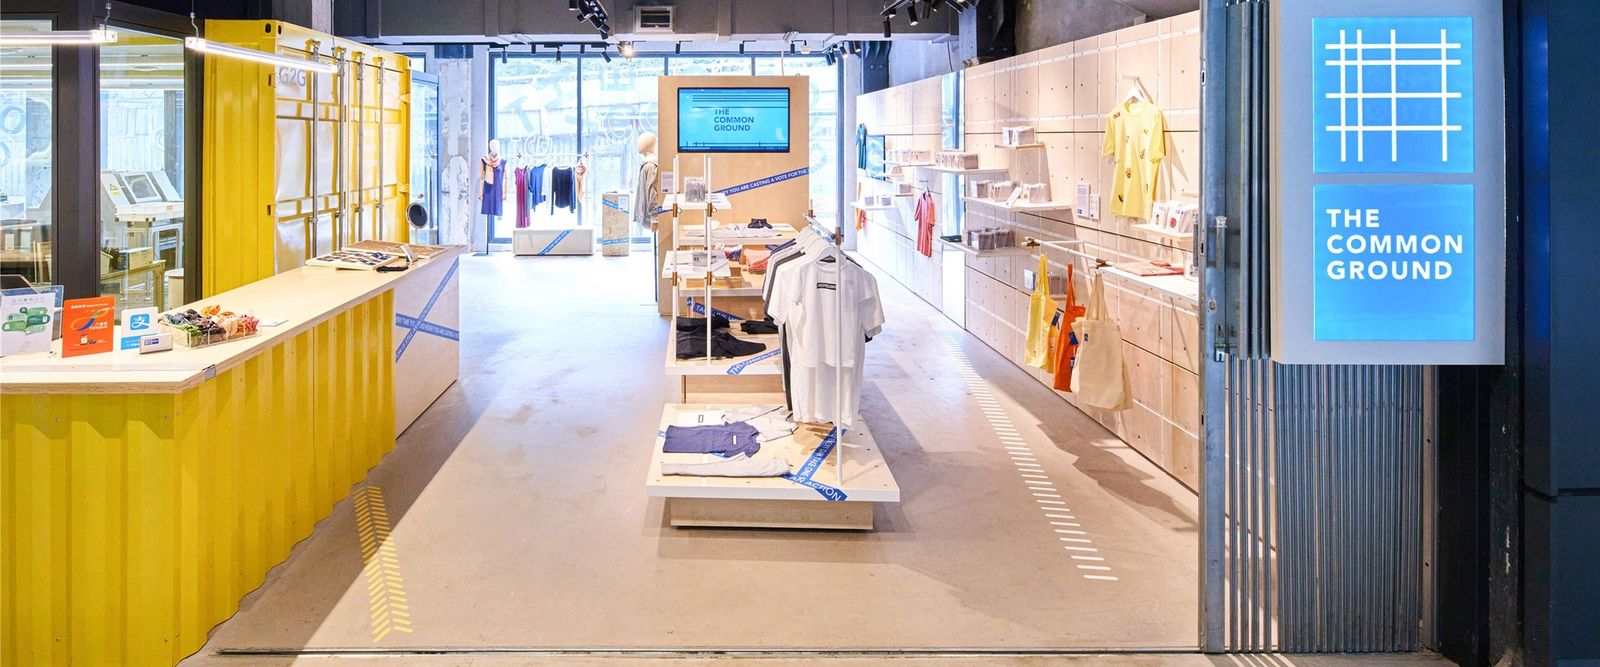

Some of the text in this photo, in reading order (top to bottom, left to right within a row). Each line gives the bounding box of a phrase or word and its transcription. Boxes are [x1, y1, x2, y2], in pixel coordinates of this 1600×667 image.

[278, 66, 306, 87] G2G
[713, 116, 755, 124] COMMON
[713, 124, 751, 132] GROUND
[749, 179, 771, 189] CASTING
[1326, 208, 1380, 228] THE
[1326, 234, 1463, 254] COMMON
[1326, 260, 1453, 280] GROUND
[804, 481, 842, 502] ACTION
